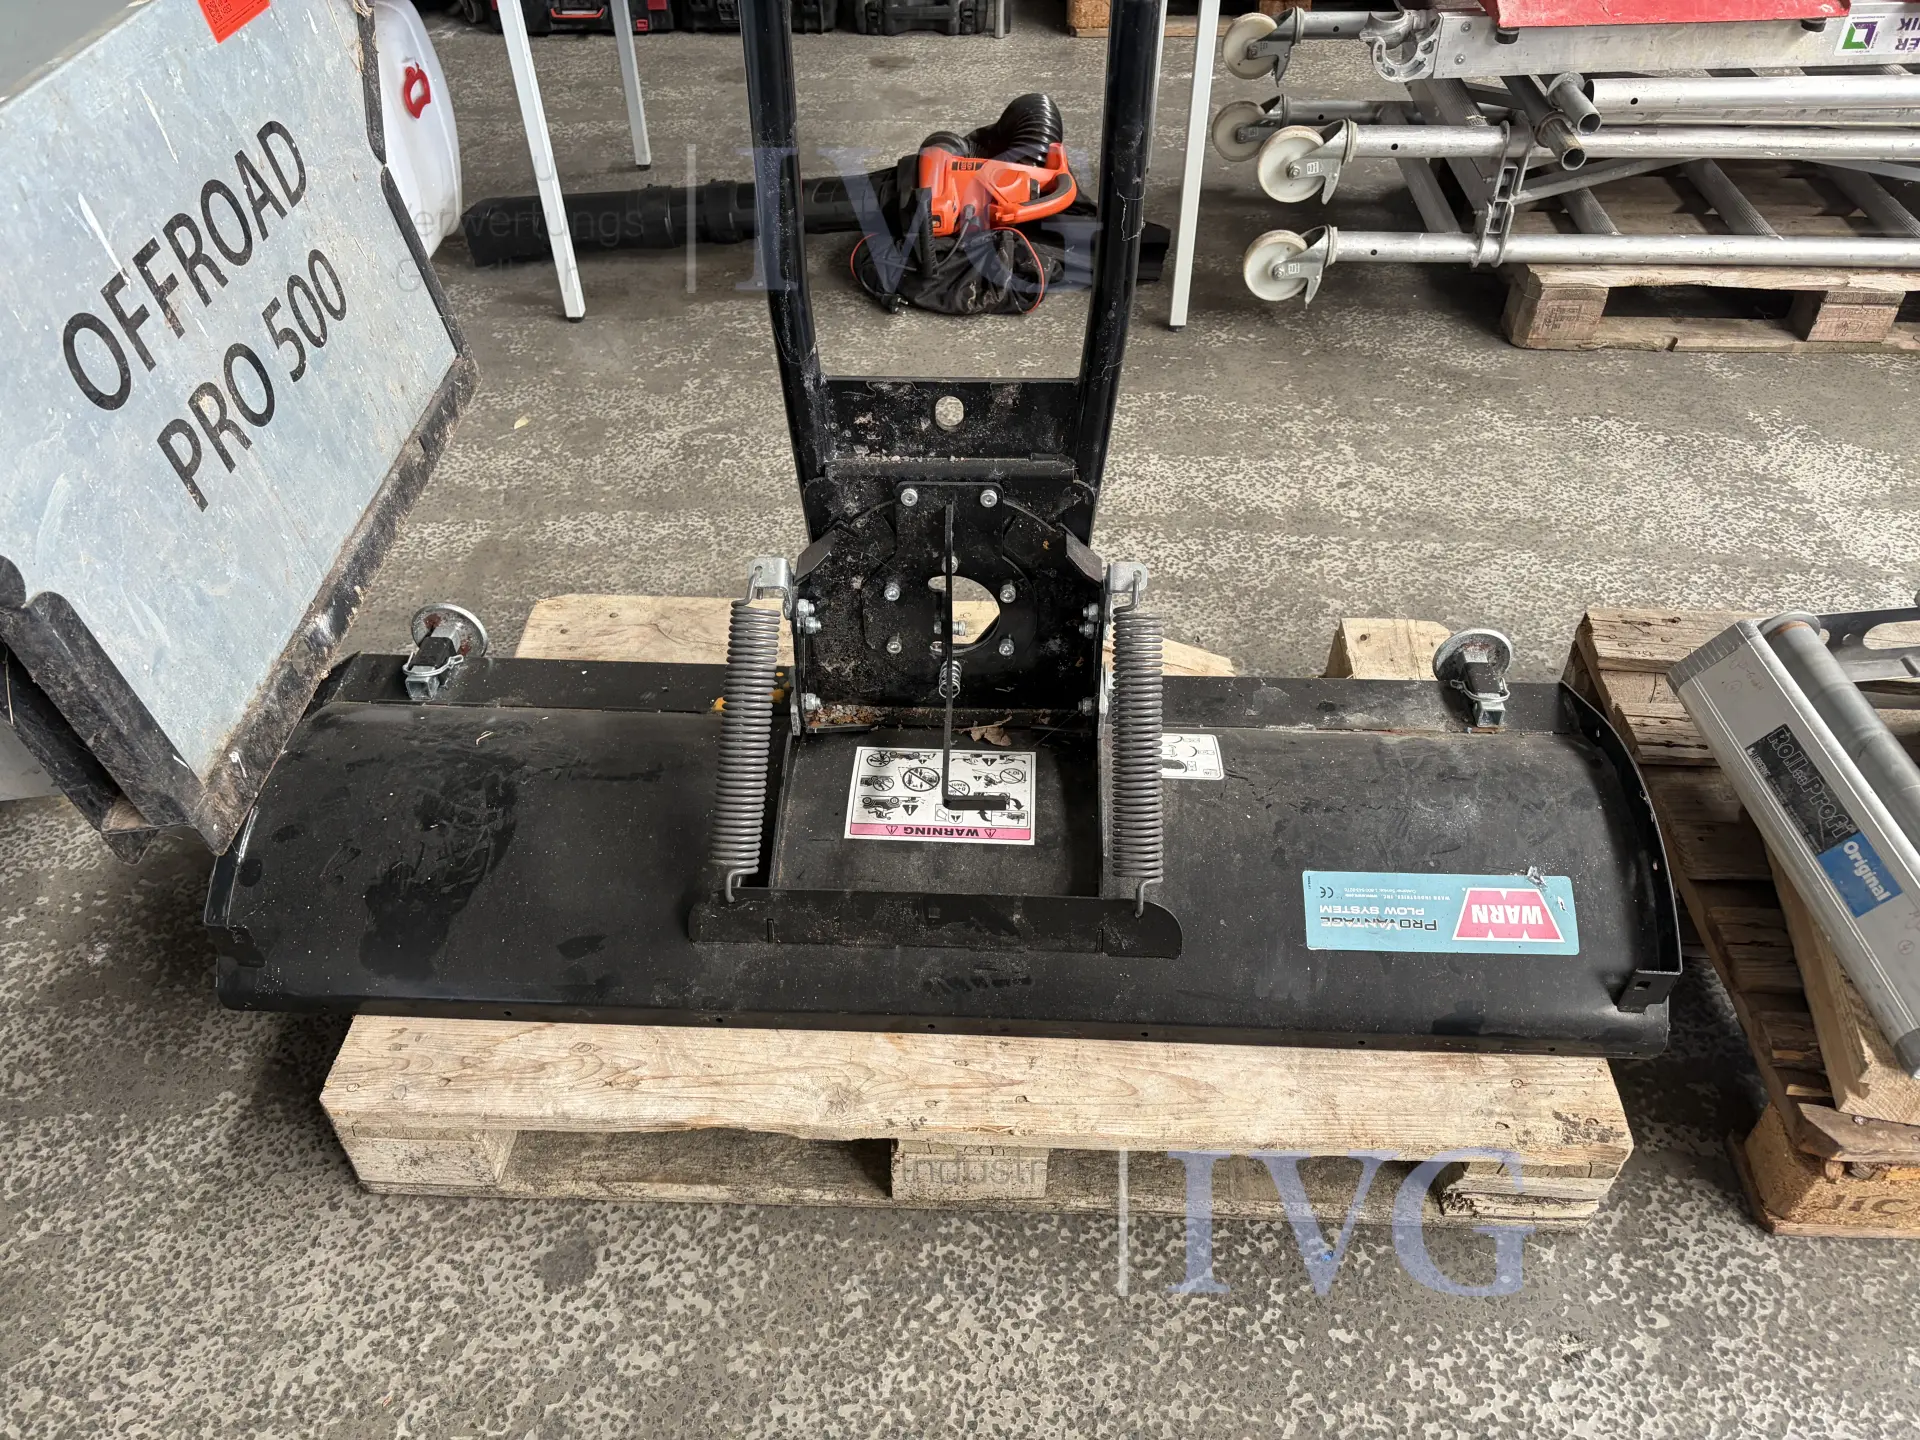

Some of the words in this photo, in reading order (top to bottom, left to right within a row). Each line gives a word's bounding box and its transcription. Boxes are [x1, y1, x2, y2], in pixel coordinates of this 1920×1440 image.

[62, 120, 308, 411] OFFROAD
[156, 342, 275, 513] PRO
[262, 249, 347, 383] 500
[903, 826, 980, 838] WARNING
[1843, 840, 1892, 902] Original
[1319, 904, 1380, 915] SYSTEM
[1384, 906, 1425, 916] PLOW
[1472, 905, 1543, 925] WARN
